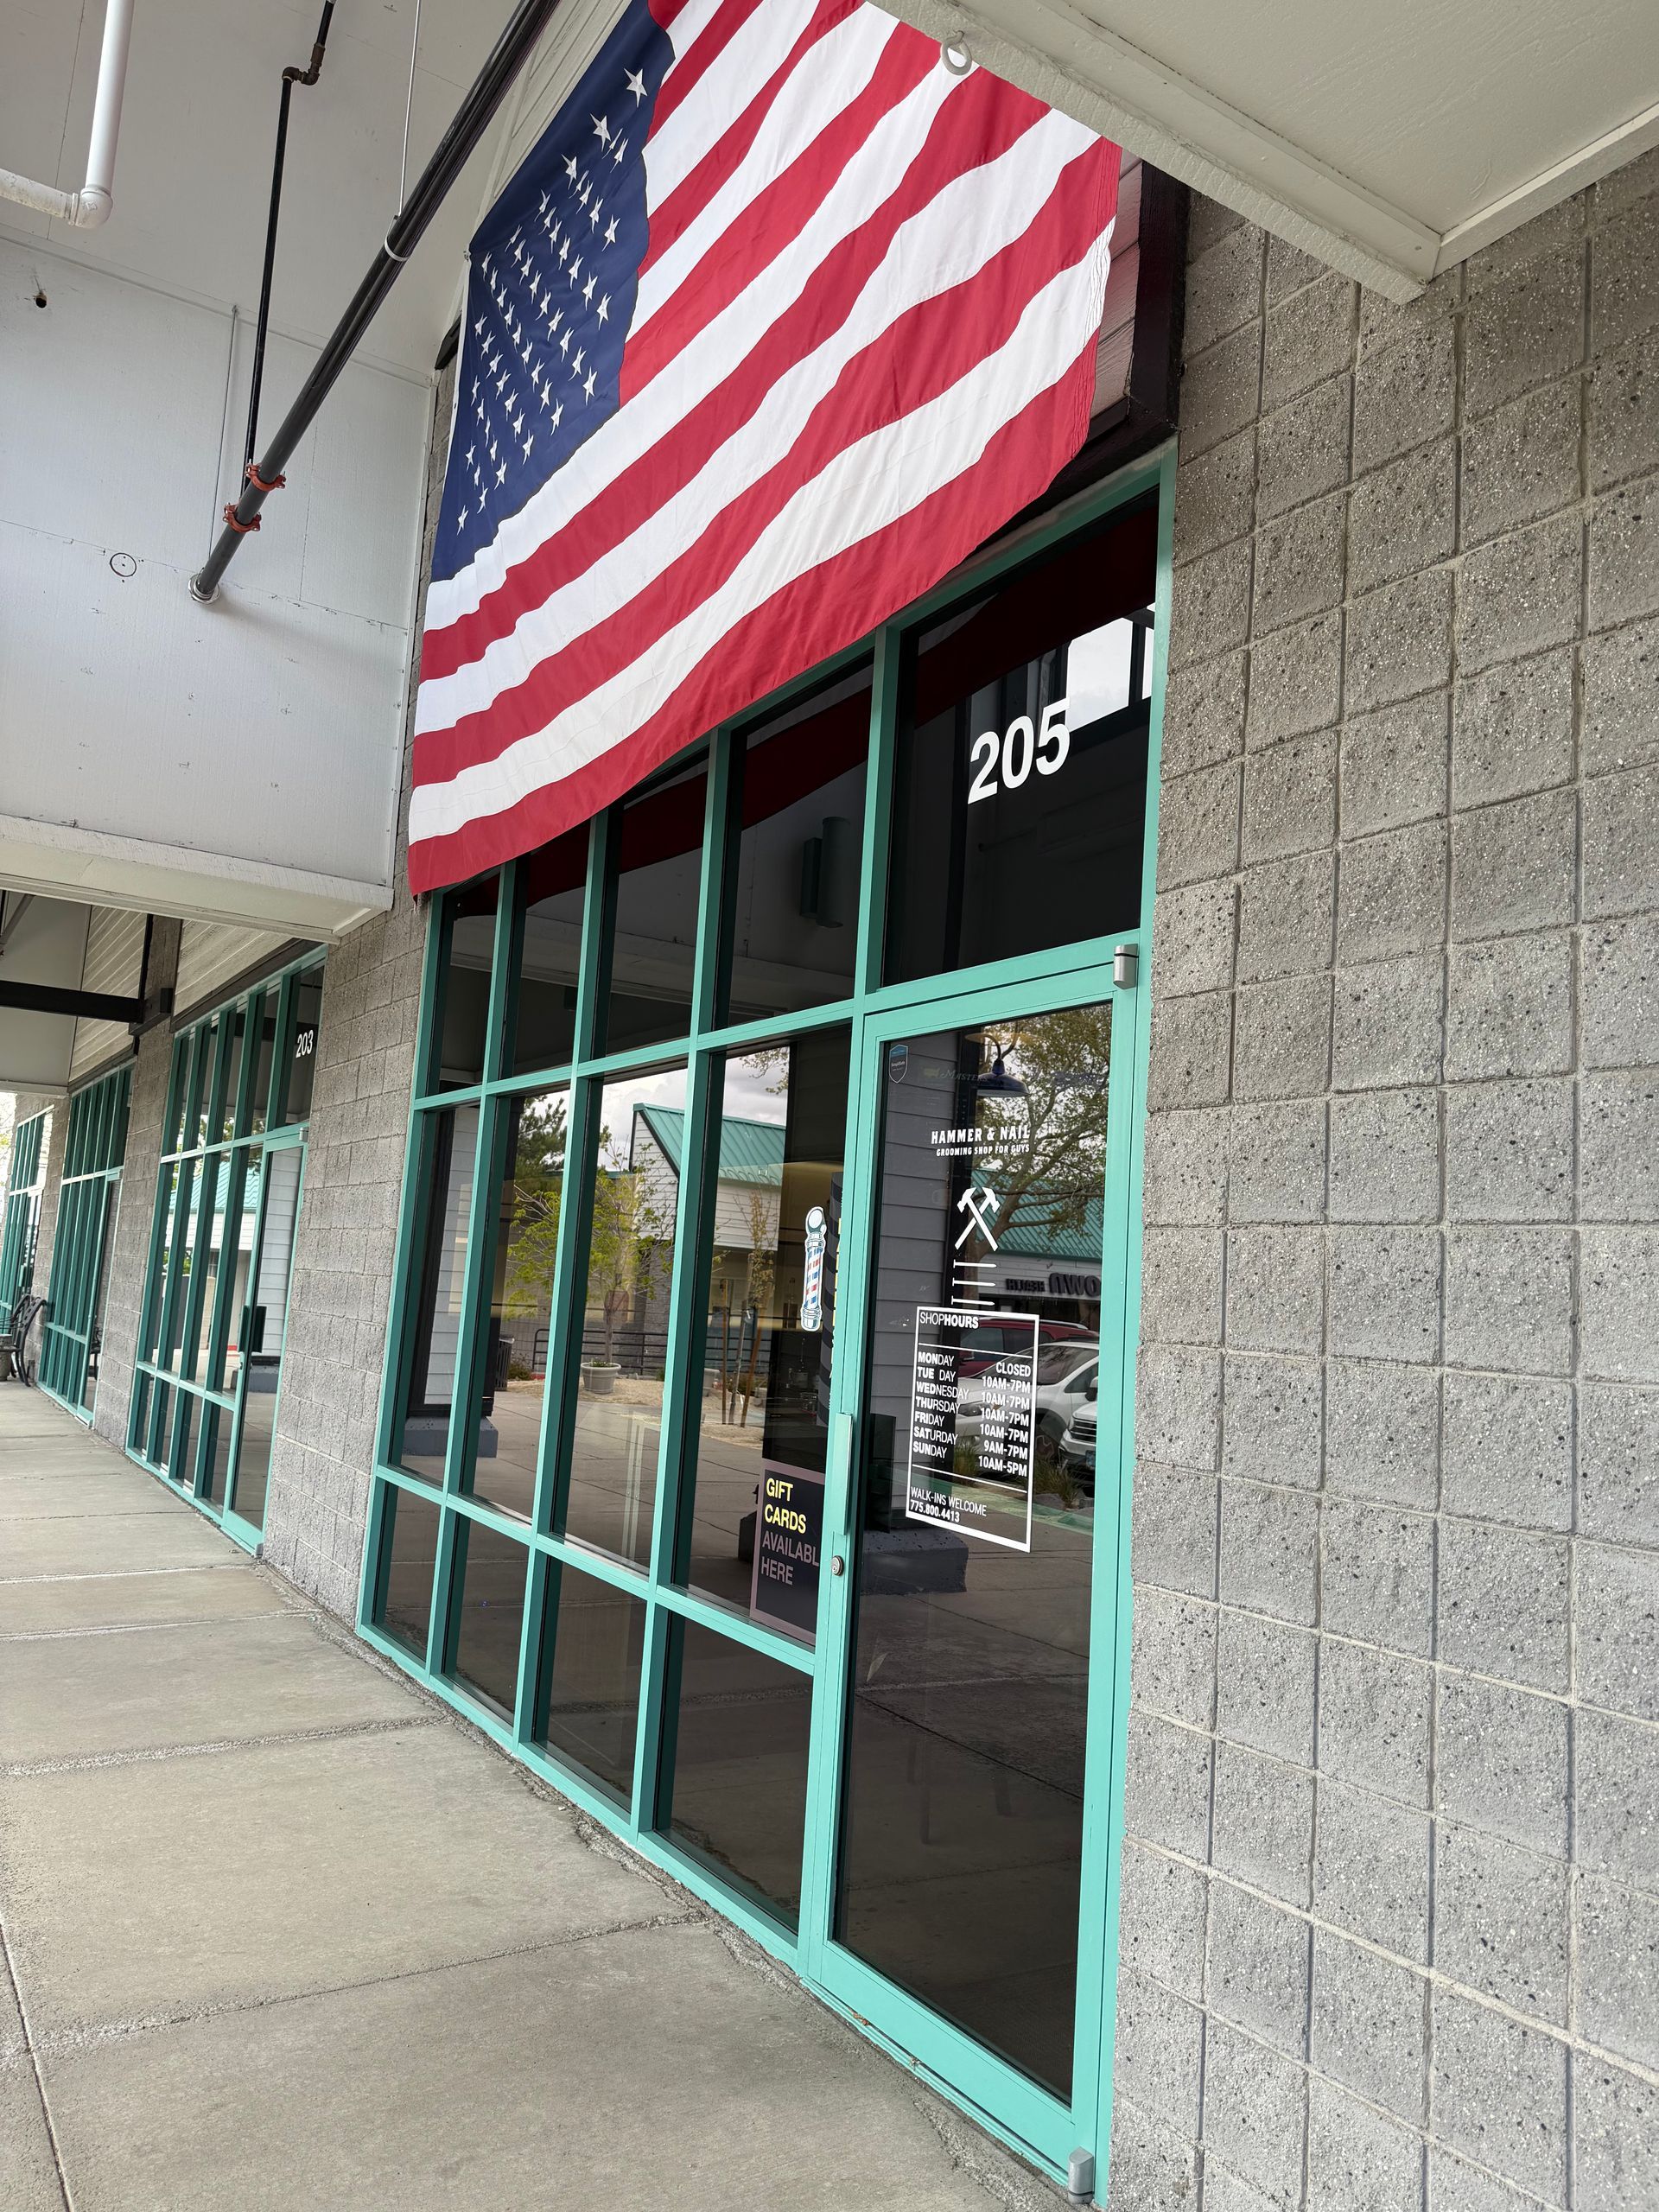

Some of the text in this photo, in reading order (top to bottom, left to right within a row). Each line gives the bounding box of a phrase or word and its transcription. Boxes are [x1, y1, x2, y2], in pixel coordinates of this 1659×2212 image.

[968, 696, 1071, 804] 205
[296, 1029, 314, 1058] 203
[931, 1128, 982, 1144] HAMMER
[987, 1127, 995, 1141] &
[936, 1143, 1030, 1157] GROOMING SHOP FOR GUYS
[919, 1312, 979, 1330] SHOPHOURS
[918, 1351, 1032, 1377] MONDAY CLOSED
[917, 1366, 1031, 1394] TUE DAY 10AM-7PM
[916, 1381, 1030, 1410] WEDNESDAY 10AM-7PM
[915, 1396, 1029, 1427] THURSDAY 10AM-7PM
[914, 1410, 1029, 1444] FRIDAY 10AM-7PM
[913, 1426, 1028, 1460] SATURDAY 9AM-7PM
[912, 1440, 1027, 1478] SUNDAY 10AM-5PM
[766, 1478, 794, 1502] GIFT
[911, 1486, 988, 1516] WALK-INS WELCOME
[764, 1503, 807, 1534] CARDS
[910, 1499, 960, 1522] 775.800.4413
[762, 1530, 820, 1567] AVAILABL
[760, 1556, 794, 1586] HERE
